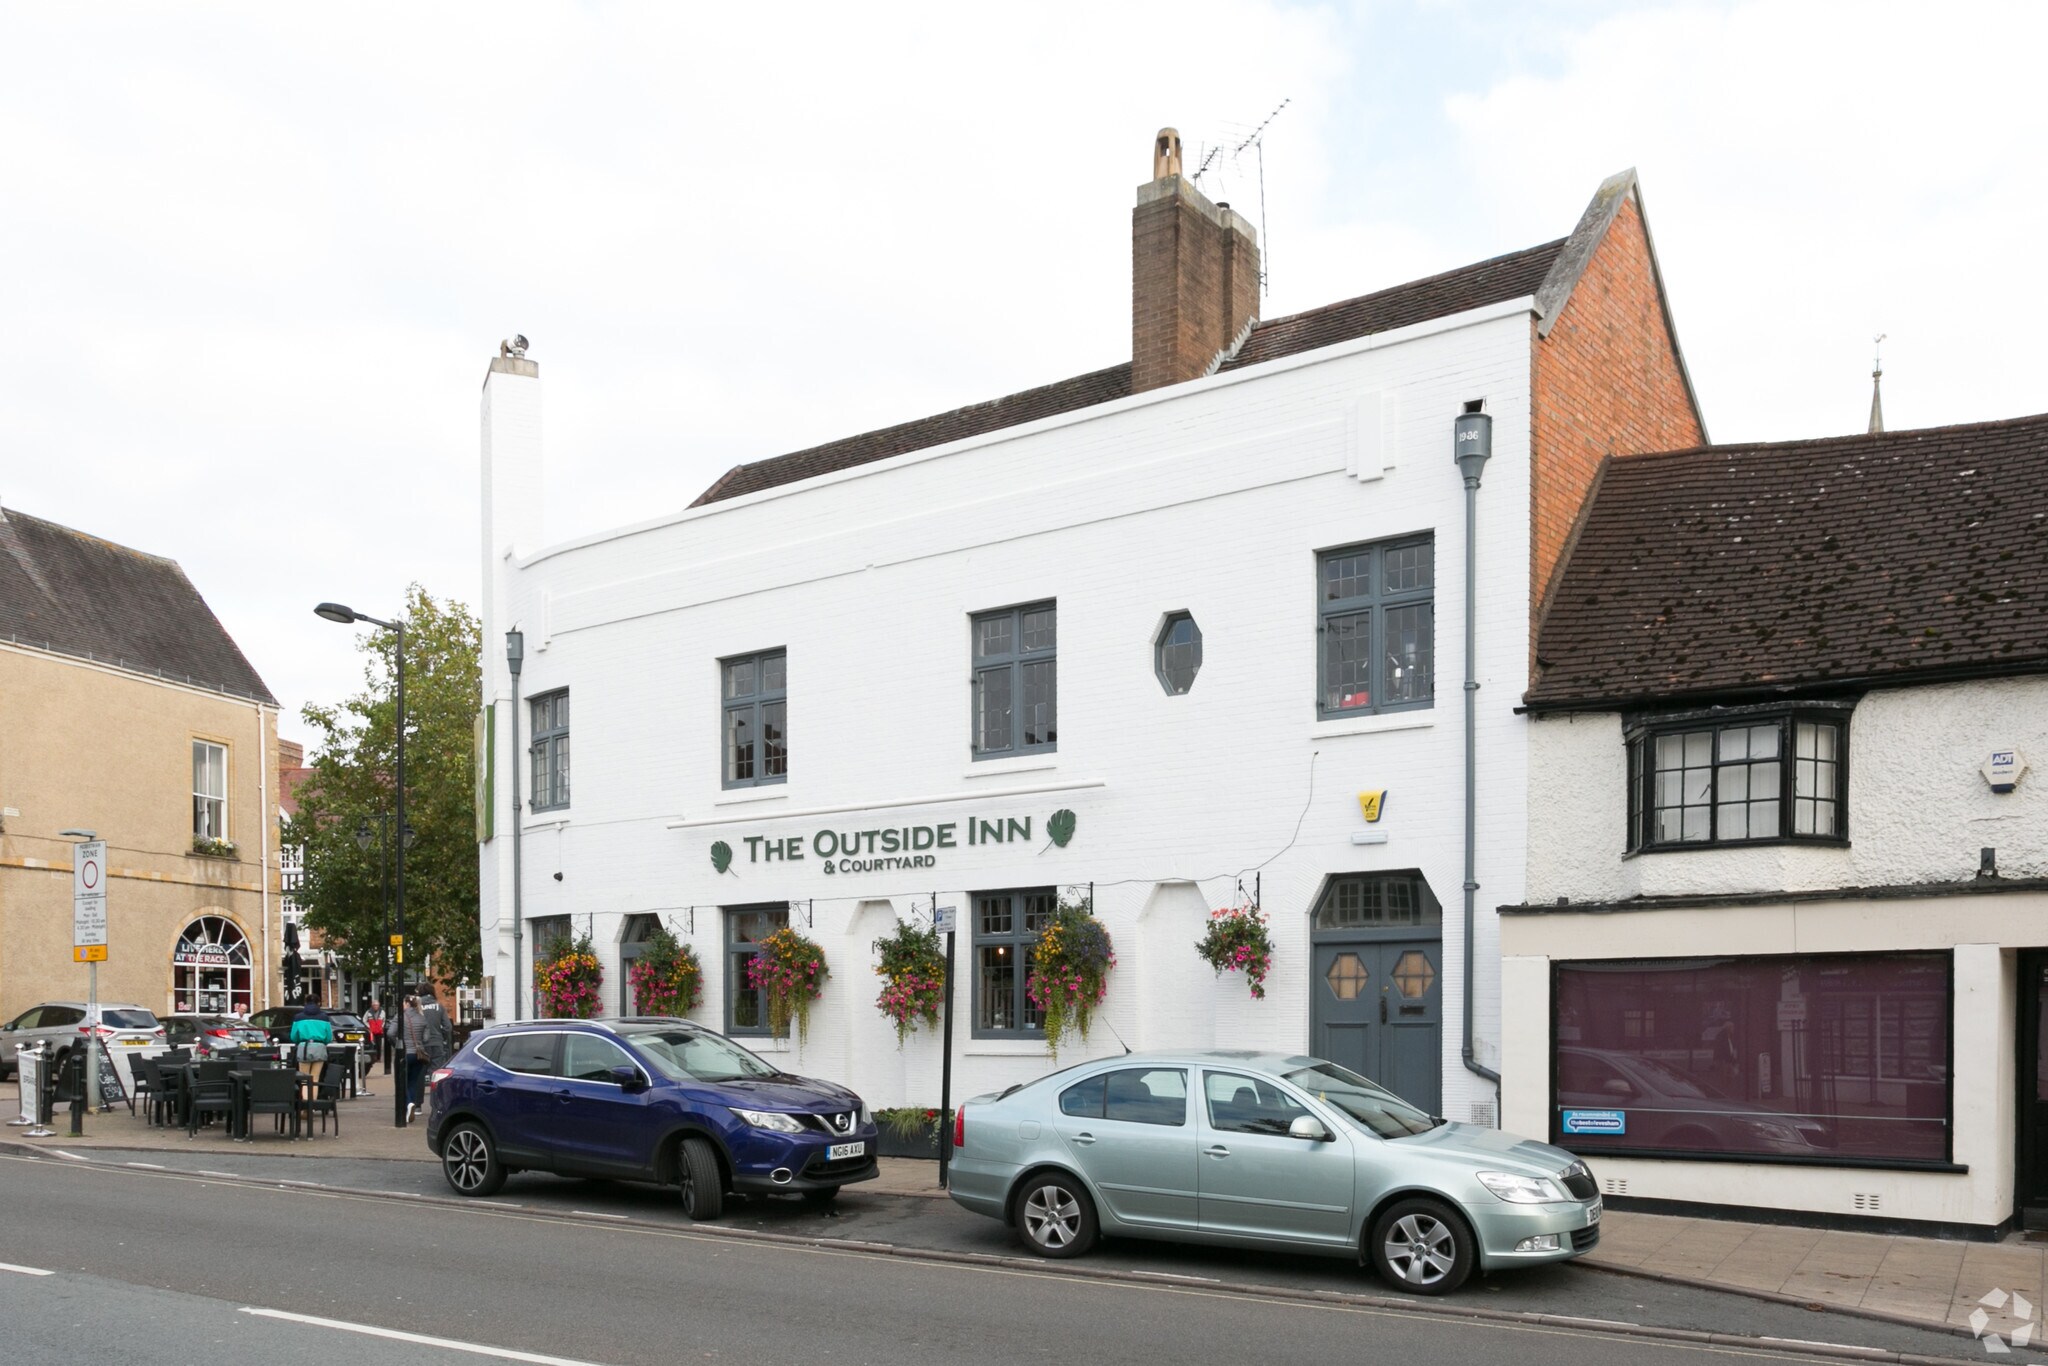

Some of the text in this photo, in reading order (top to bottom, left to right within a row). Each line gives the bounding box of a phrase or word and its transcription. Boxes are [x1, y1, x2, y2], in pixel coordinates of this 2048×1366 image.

[1992, 753, 2014, 765] ADT
[743, 816, 1031, 862] THE OUTSIDE INN
[82, 850, 98, 858] ZONE
[823, 855, 936, 875] & COURTYARD
[175, 953, 185, 961] AT
[98, 1073, 116, 1084] Cake
